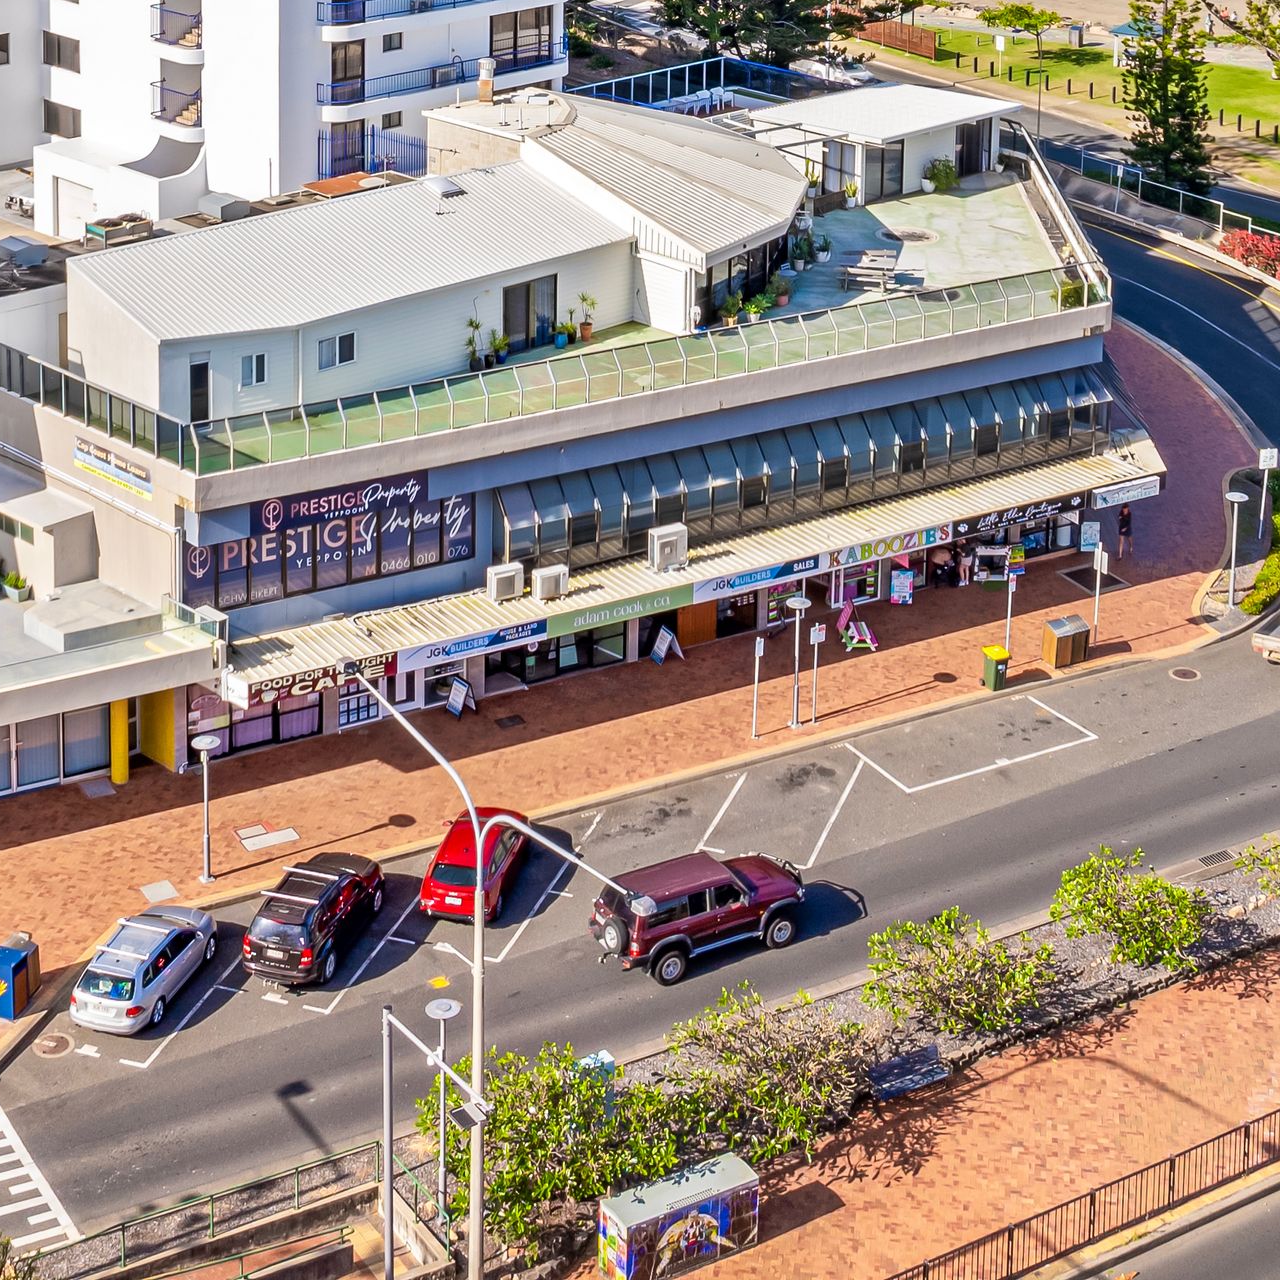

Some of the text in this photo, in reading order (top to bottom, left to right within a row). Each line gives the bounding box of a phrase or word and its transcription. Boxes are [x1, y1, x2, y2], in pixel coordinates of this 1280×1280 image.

[126, 463, 147, 479] Loans
[291, 478, 421, 519] PRESTIGE Property
[324, 506, 365, 520] YEPPOON
[381, 558, 411, 573] 0466
[417, 552, 436, 566] 010
[447, 545, 469, 559] 076
[712, 578, 735, 592] JGK
[735, 569, 772, 586] BUILDERS
[793, 559, 815, 572] SALES
[574, 608, 610, 627] adam
[613, 600, 644, 617] cook
[426, 644, 451, 660] JGK
[450, 636, 489, 654] BUILDERS
[251, 652, 396, 694] FOOD FOR THUGHT
[290, 664, 386, 696] CAFE
